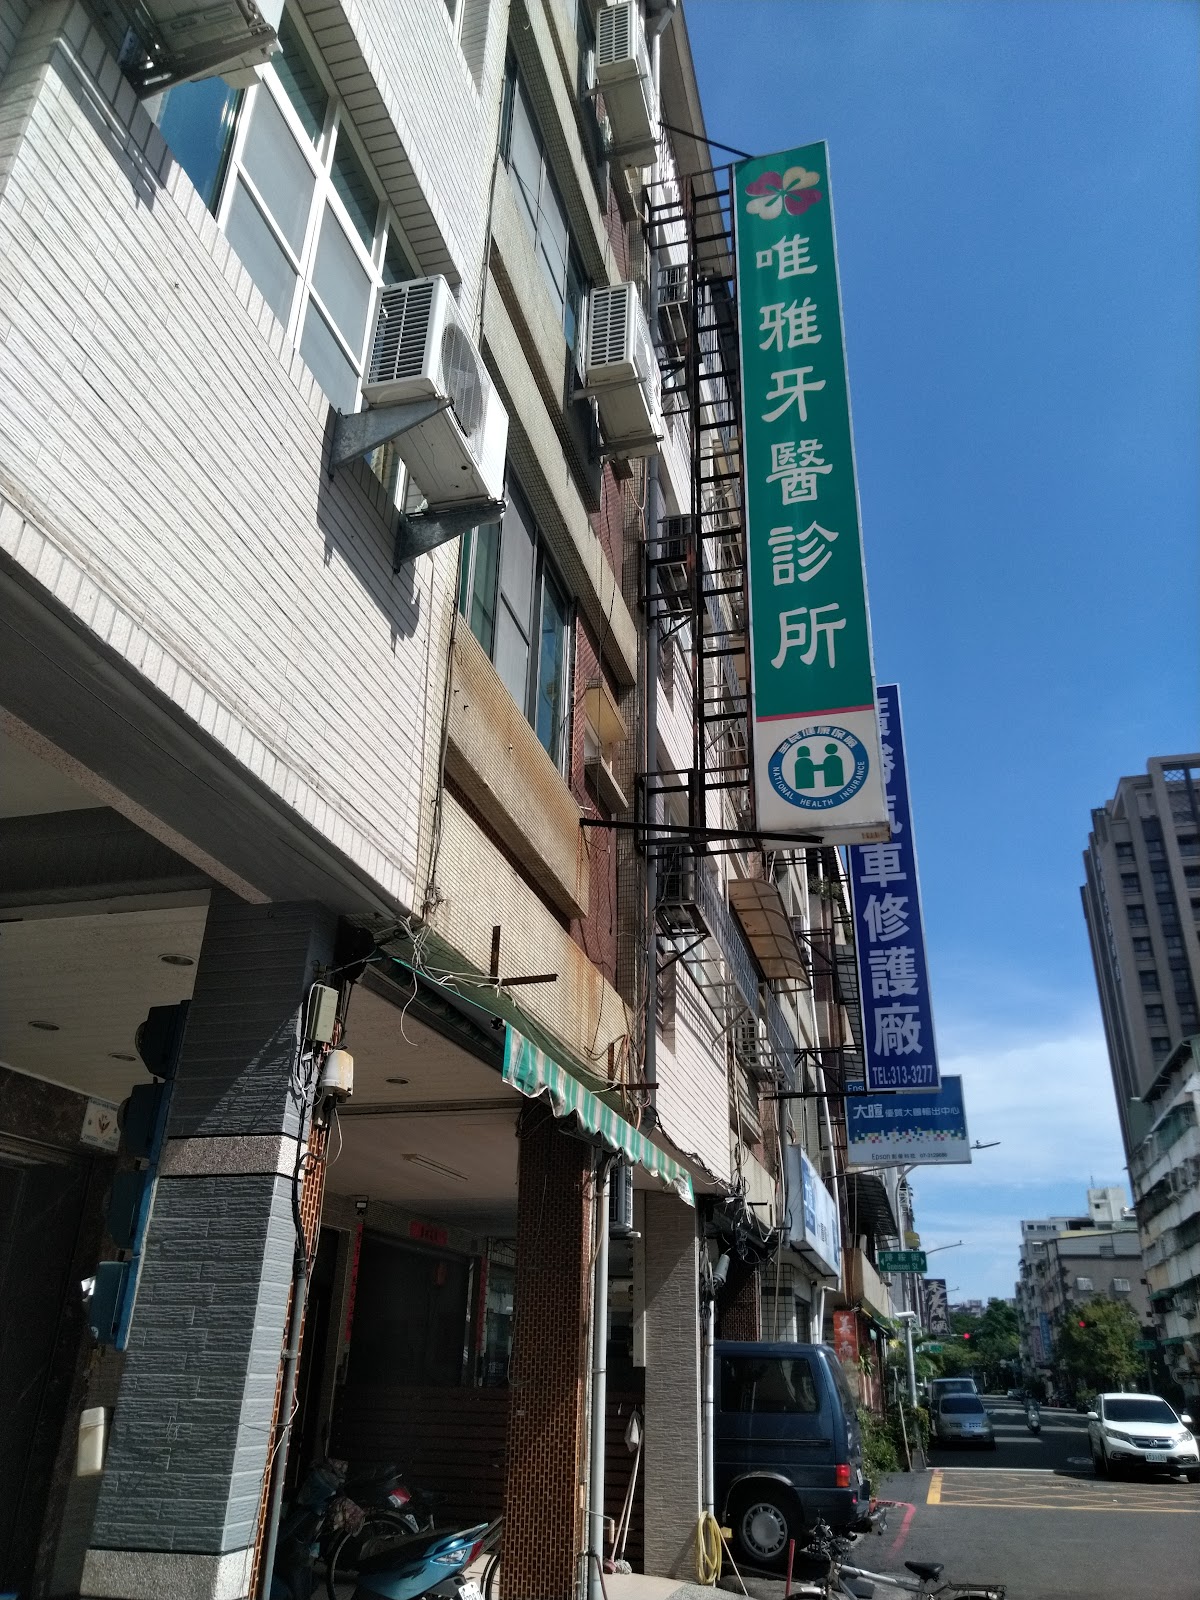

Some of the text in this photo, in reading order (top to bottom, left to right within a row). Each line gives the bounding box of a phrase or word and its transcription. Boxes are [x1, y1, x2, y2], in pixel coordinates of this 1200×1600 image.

[756, 233, 847, 669] 唯雅牙醫診所
[772, 760, 866, 808] NATIONAL HEALTH INSURANCE
[859, 697, 924, 1057] 車修護廠
[872, 1064, 933, 1086] TEL:313-3277
